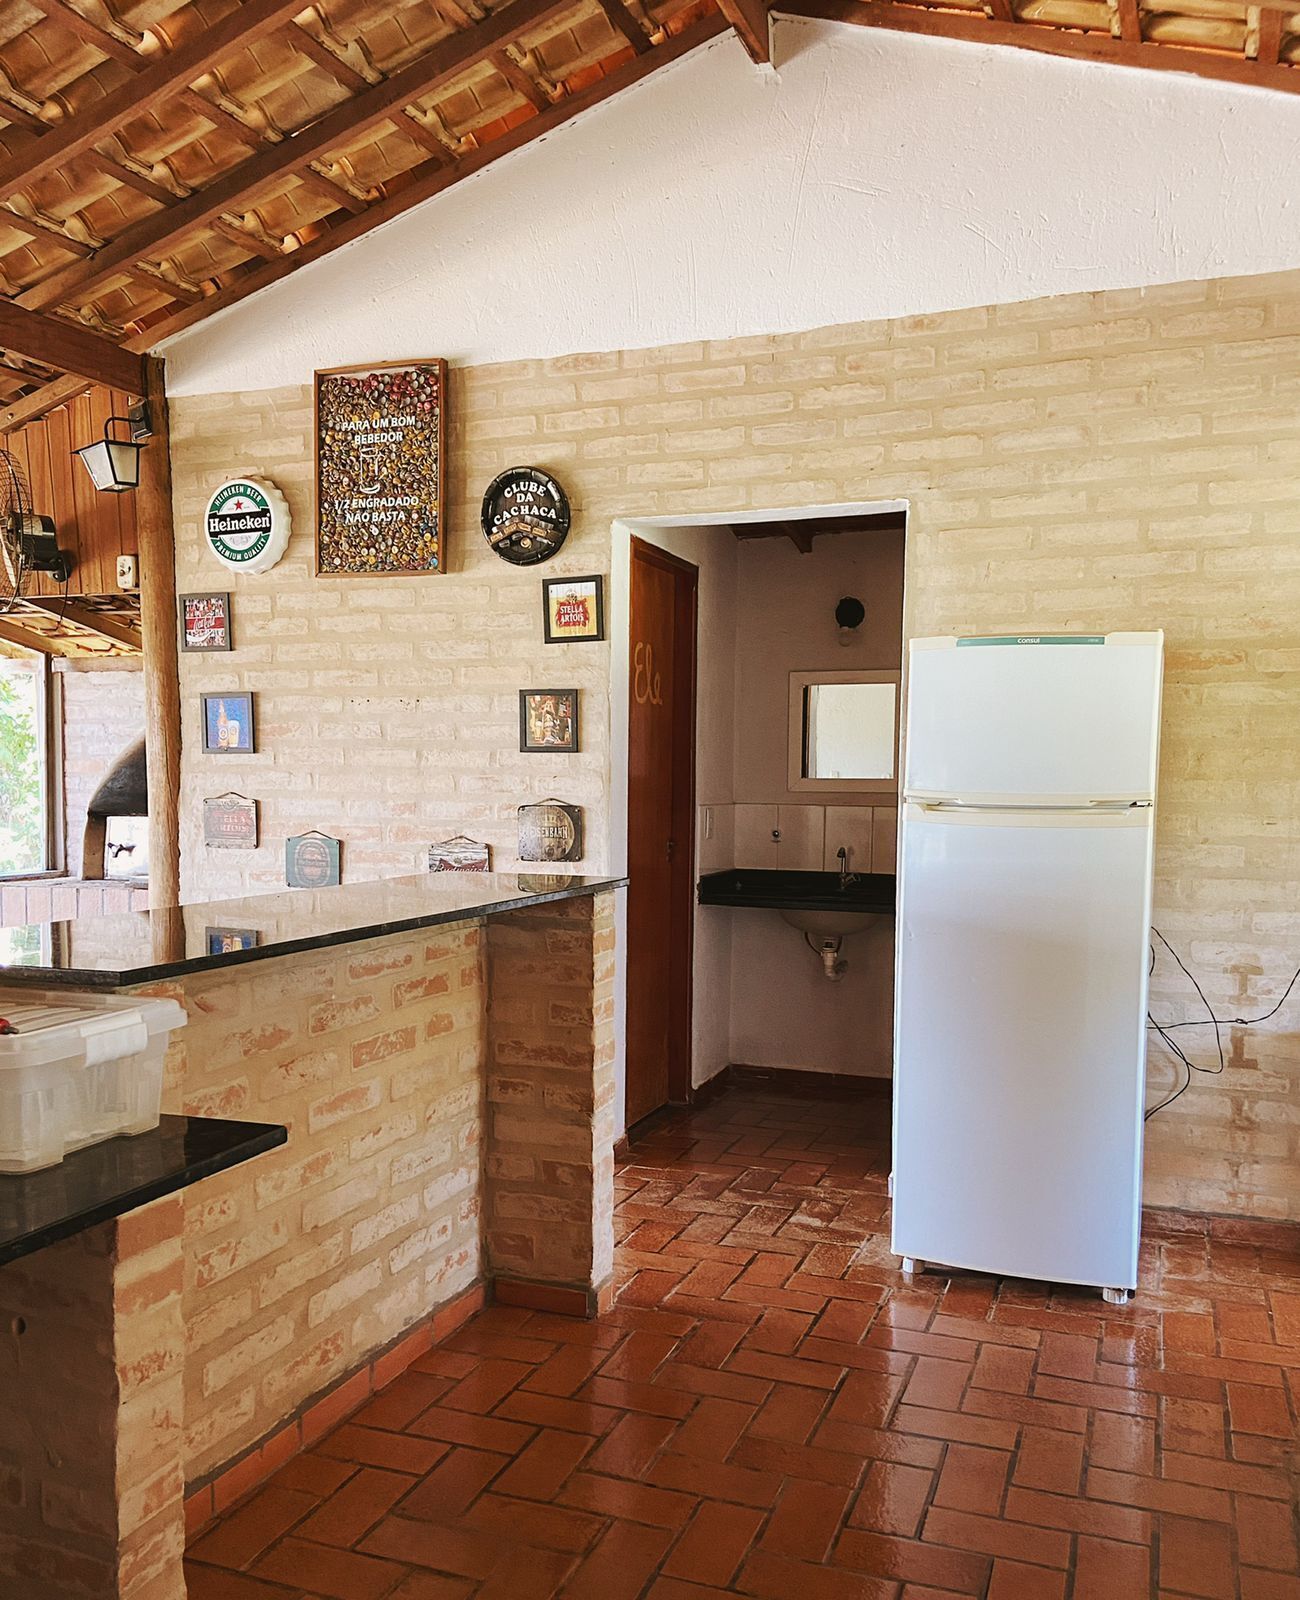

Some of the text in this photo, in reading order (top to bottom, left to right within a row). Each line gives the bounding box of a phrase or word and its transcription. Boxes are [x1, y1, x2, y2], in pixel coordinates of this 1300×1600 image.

[342, 415, 416, 431] PARA UM BOM
[354, 431, 403, 445] BEBEDOR
[214, 485, 262, 506] HEINEKEN BEER
[504, 481, 547, 498] CLUBE
[334, 496, 419, 510] 1/2 ENGRADADO
[516, 492, 534, 503] DA
[209, 515, 270, 532] Heineken
[371, 511, 406, 522] BASTA
[214, 539, 266, 560] PREMIUM QUALITY
[560, 604, 584, 614] STELLA
[560, 613, 585, 624] ARTOIS
[634, 641, 663, 704] Ele
[527, 826, 568, 839] SENBAHN
